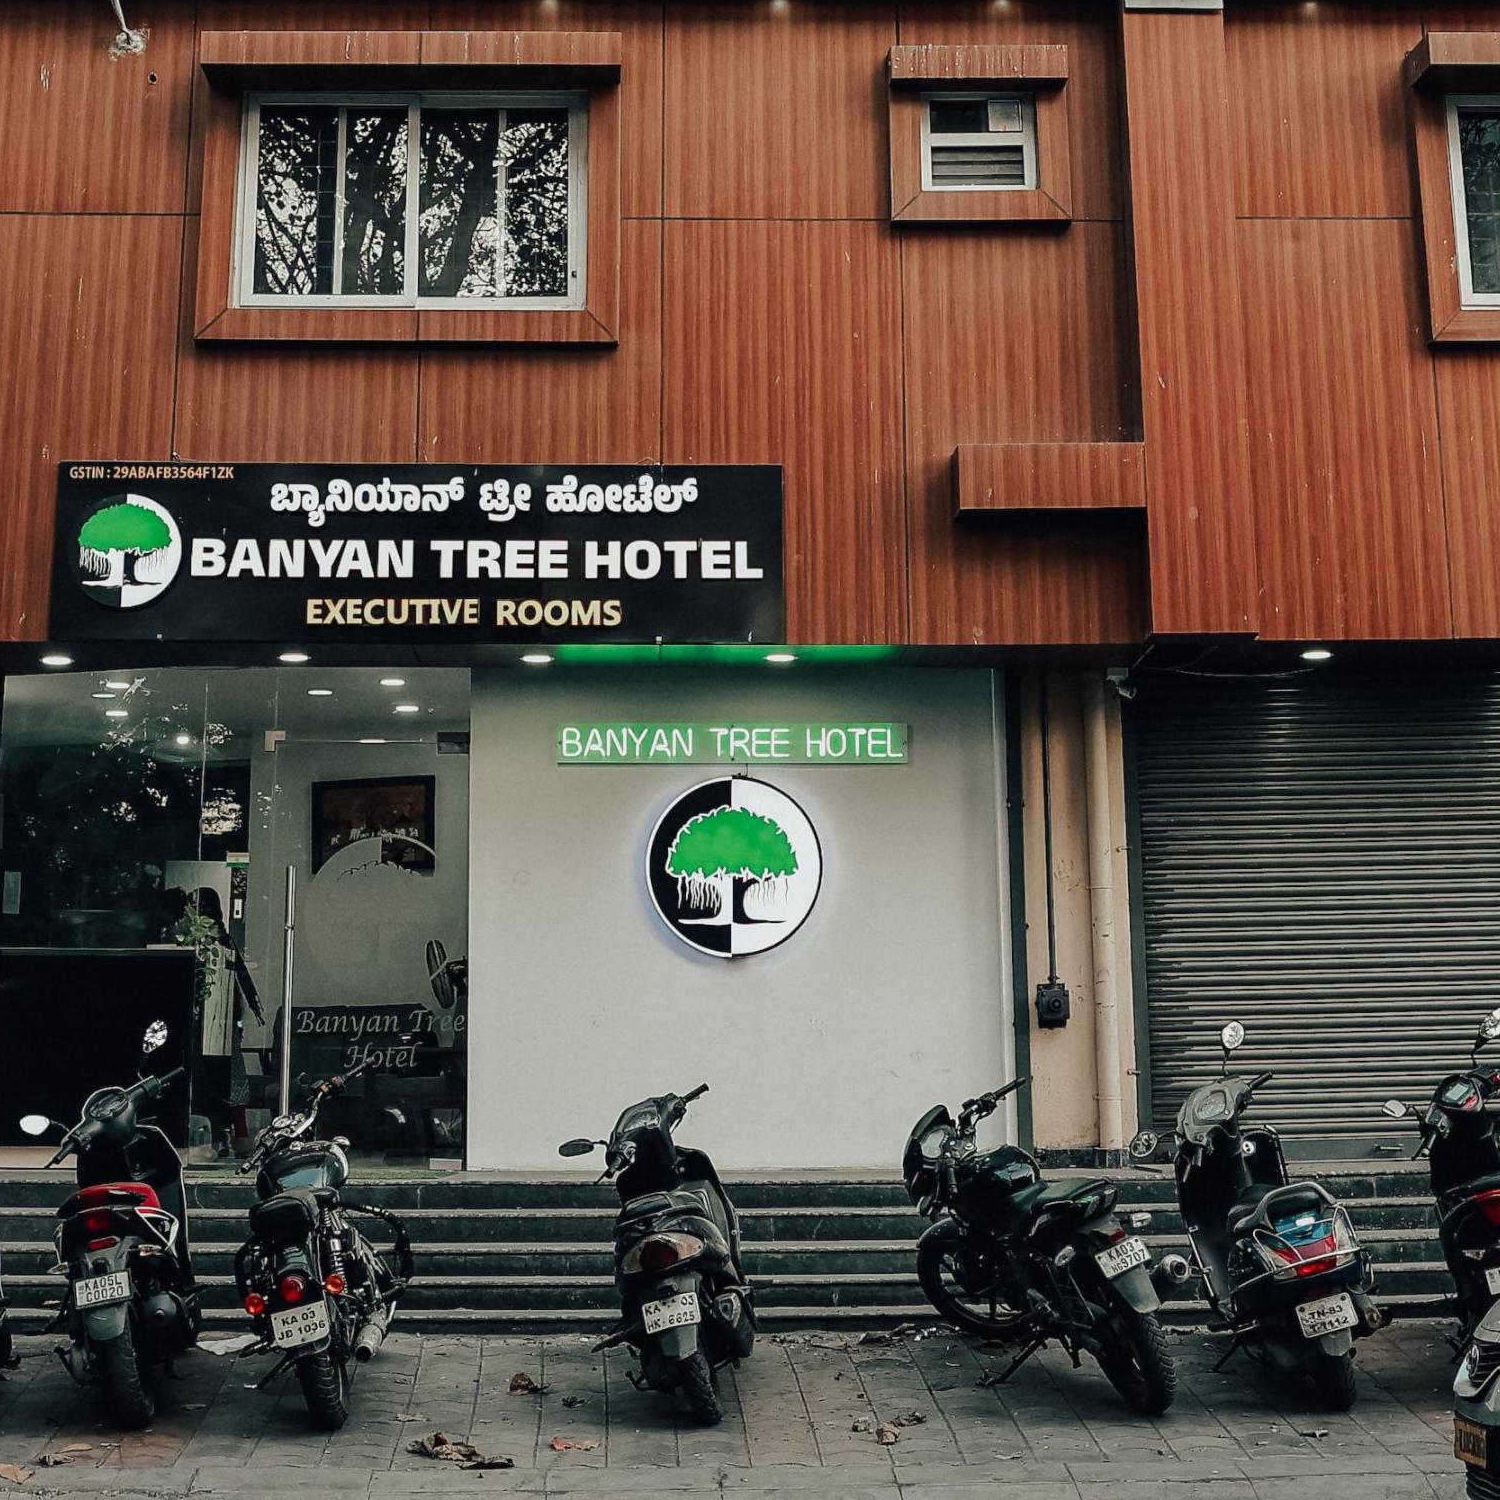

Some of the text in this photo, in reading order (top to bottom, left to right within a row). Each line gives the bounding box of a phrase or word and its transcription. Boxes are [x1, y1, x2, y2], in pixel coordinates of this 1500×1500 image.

[69, 466, 104, 479] GSTIN
[190, 538, 764, 580] BANYAN TREE HOTEL
[306, 598, 622, 626] EXECUTIVE ROOMS
[561, 727, 904, 758] BANYAN TREE HOTEL
[296, 1009, 466, 1042] Banyan Tree
[343, 1041, 424, 1069] Hotel
[1106, 1241, 1135, 1262] KA03
[84, 1274, 123, 1292] KA05L
[644, 1295, 695, 1317] KA 03
[281, 1310, 316, 1327] KA 03
[297, 1320, 326, 1335] 1036
[668, 1310, 695, 1325] 6625
